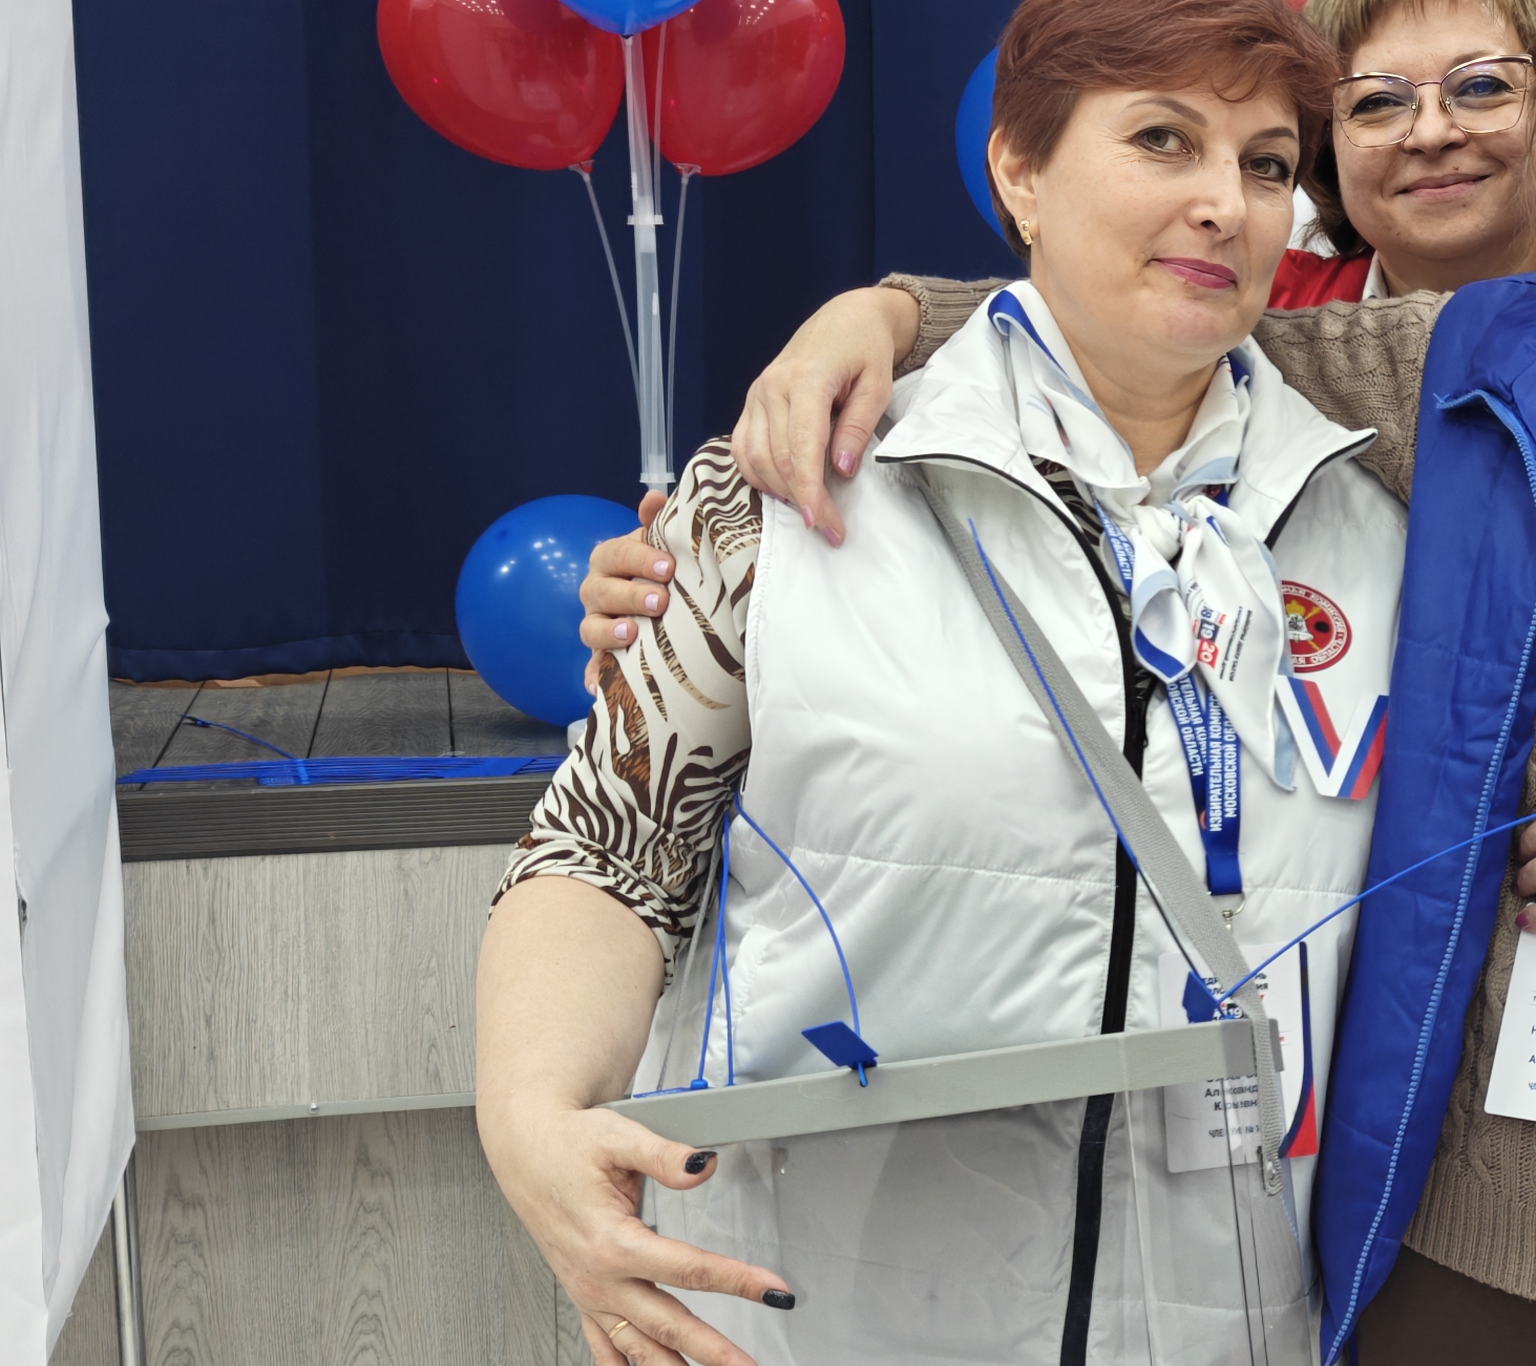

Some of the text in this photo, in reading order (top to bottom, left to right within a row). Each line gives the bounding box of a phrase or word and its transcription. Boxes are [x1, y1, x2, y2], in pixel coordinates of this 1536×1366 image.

[1200, 641, 1215, 663] 20
[1201, 623, 1215, 639] 19
[1181, 726, 1204, 776] ОБЛАСТИ
[1209, 741, 1223, 832] ИЗБИРАТЕЛЬНАЯ
[1223, 743, 1238, 818] МОСКОВСКОЙ
